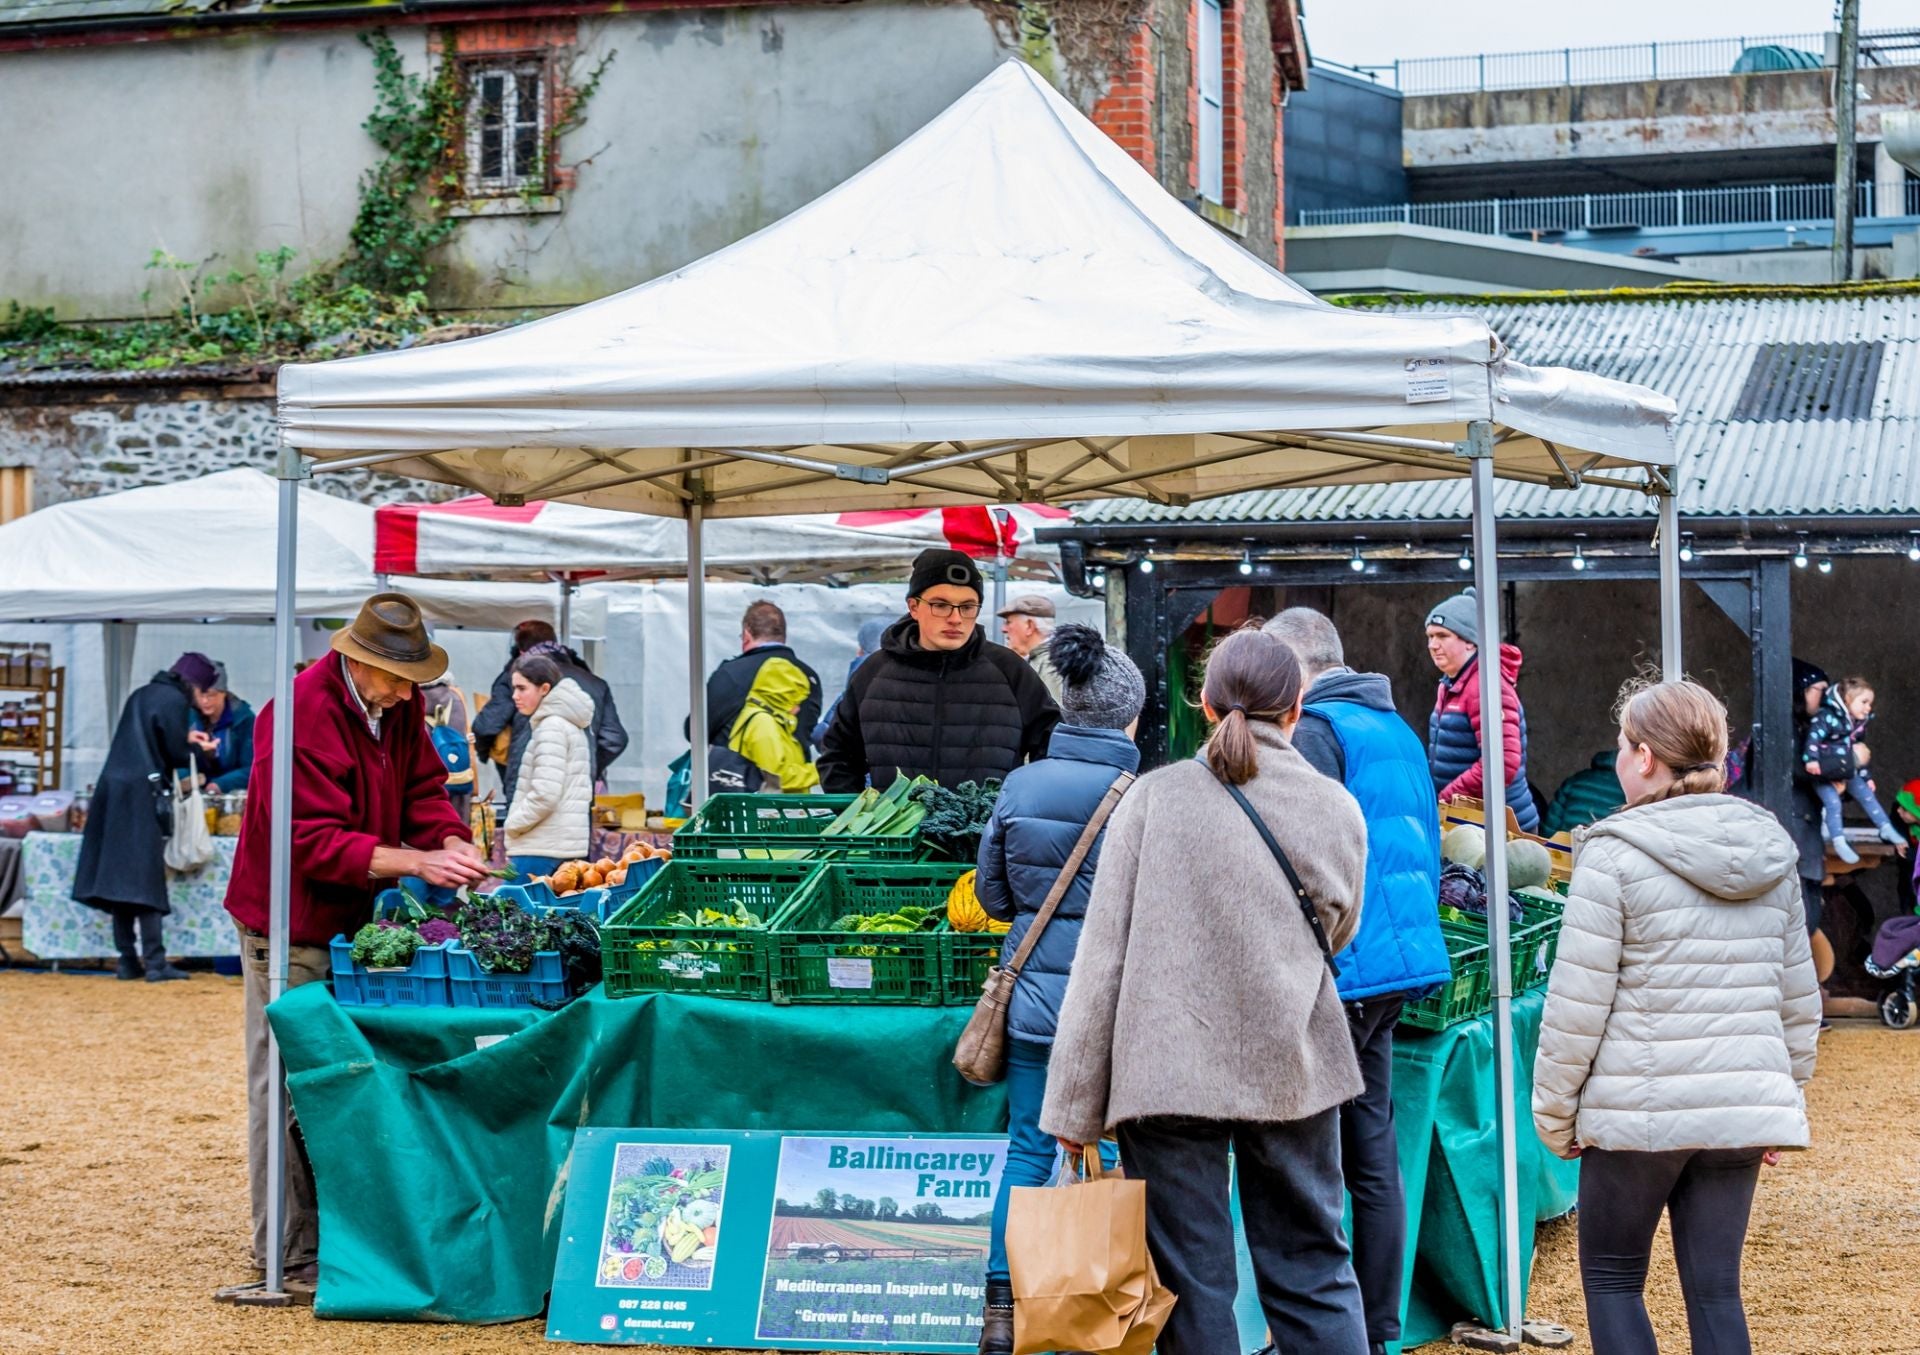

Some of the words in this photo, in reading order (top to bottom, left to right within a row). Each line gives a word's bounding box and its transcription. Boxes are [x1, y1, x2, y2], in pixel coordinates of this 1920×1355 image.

[828, 1145, 995, 1177] Ballincarey
[916, 1173, 991, 1198] Farm
[775, 1279, 882, 1294] Mediterranean
[886, 1281, 948, 1298] Inspired
[618, 1299, 639, 1309] 087
[623, 1317, 695, 1332] dermot.carey
[851, 1310, 889, 1326] here,
[893, 1313, 917, 1325] not
[920, 1312, 961, 1326] flown
